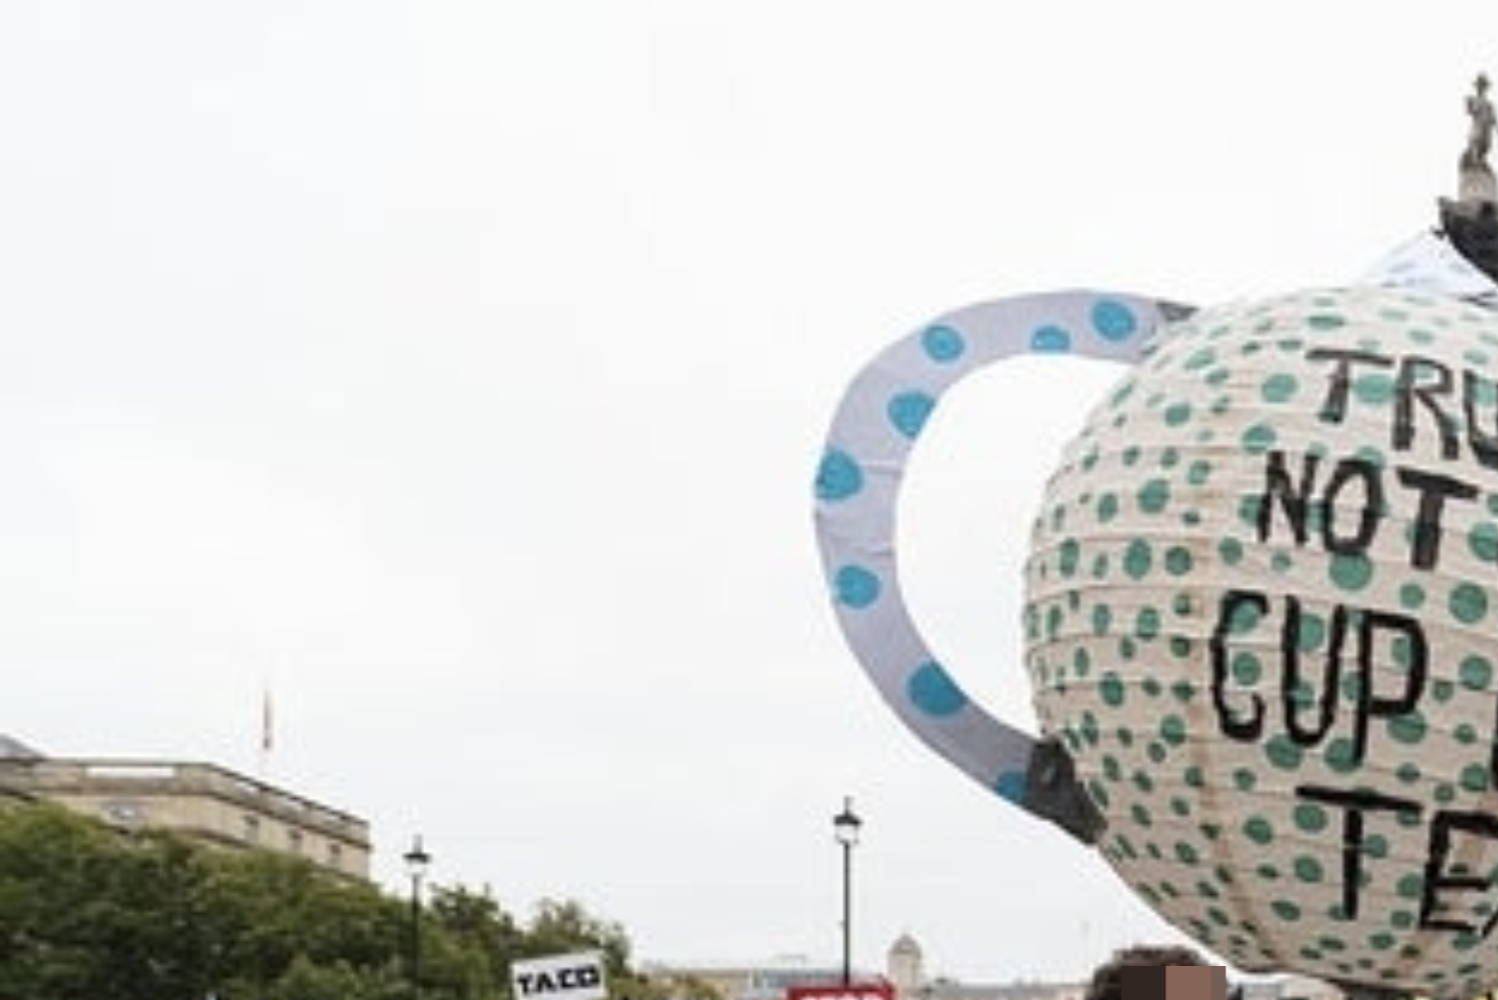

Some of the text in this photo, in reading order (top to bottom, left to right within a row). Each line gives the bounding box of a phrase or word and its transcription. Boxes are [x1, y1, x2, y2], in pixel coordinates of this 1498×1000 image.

[1257, 450, 1479, 571] NOT
[1209, 590, 1429, 767] CUP
[517, 963, 600, 995] TACO
